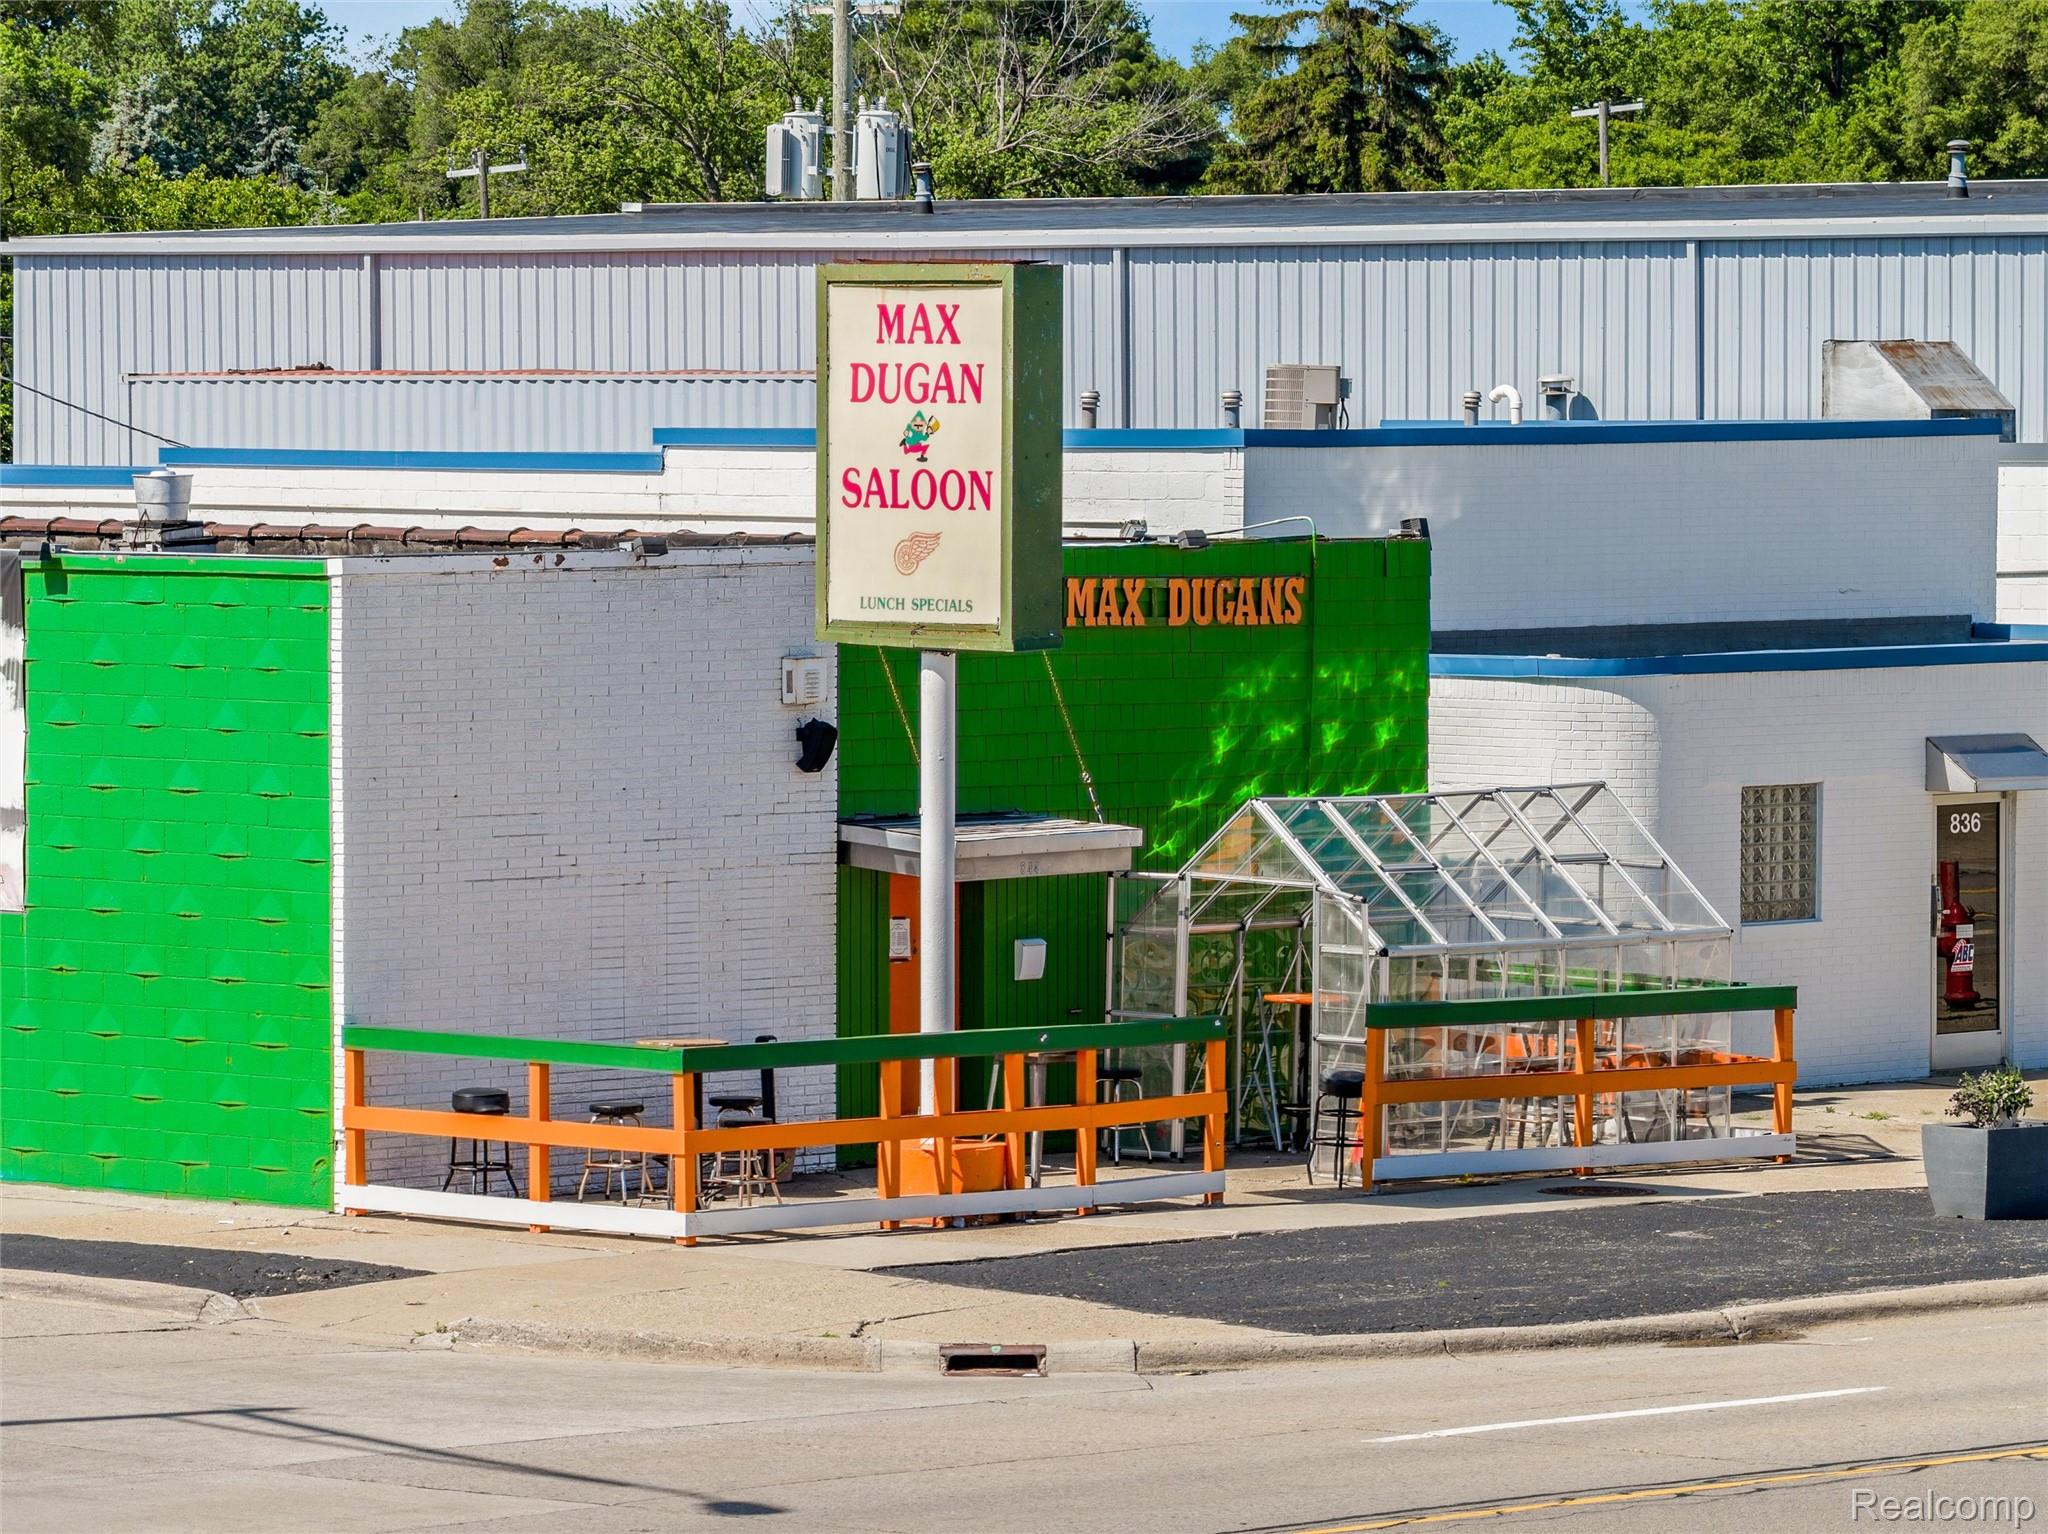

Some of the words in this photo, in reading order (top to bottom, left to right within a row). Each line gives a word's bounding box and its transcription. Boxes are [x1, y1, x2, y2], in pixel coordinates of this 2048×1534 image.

[875, 303, 961, 344] MAX
[849, 362, 985, 404] DUGAN
[842, 467, 993, 511] SALOON
[860, 596, 905, 611] LUNCH
[911, 598, 973, 613] SPECIALS
[1066, 578, 1146, 627] MAX
[1168, 577, 1304, 626] DUGANS
[1950, 812, 1981, 833] 836
[1955, 945, 1973, 961] ABC
